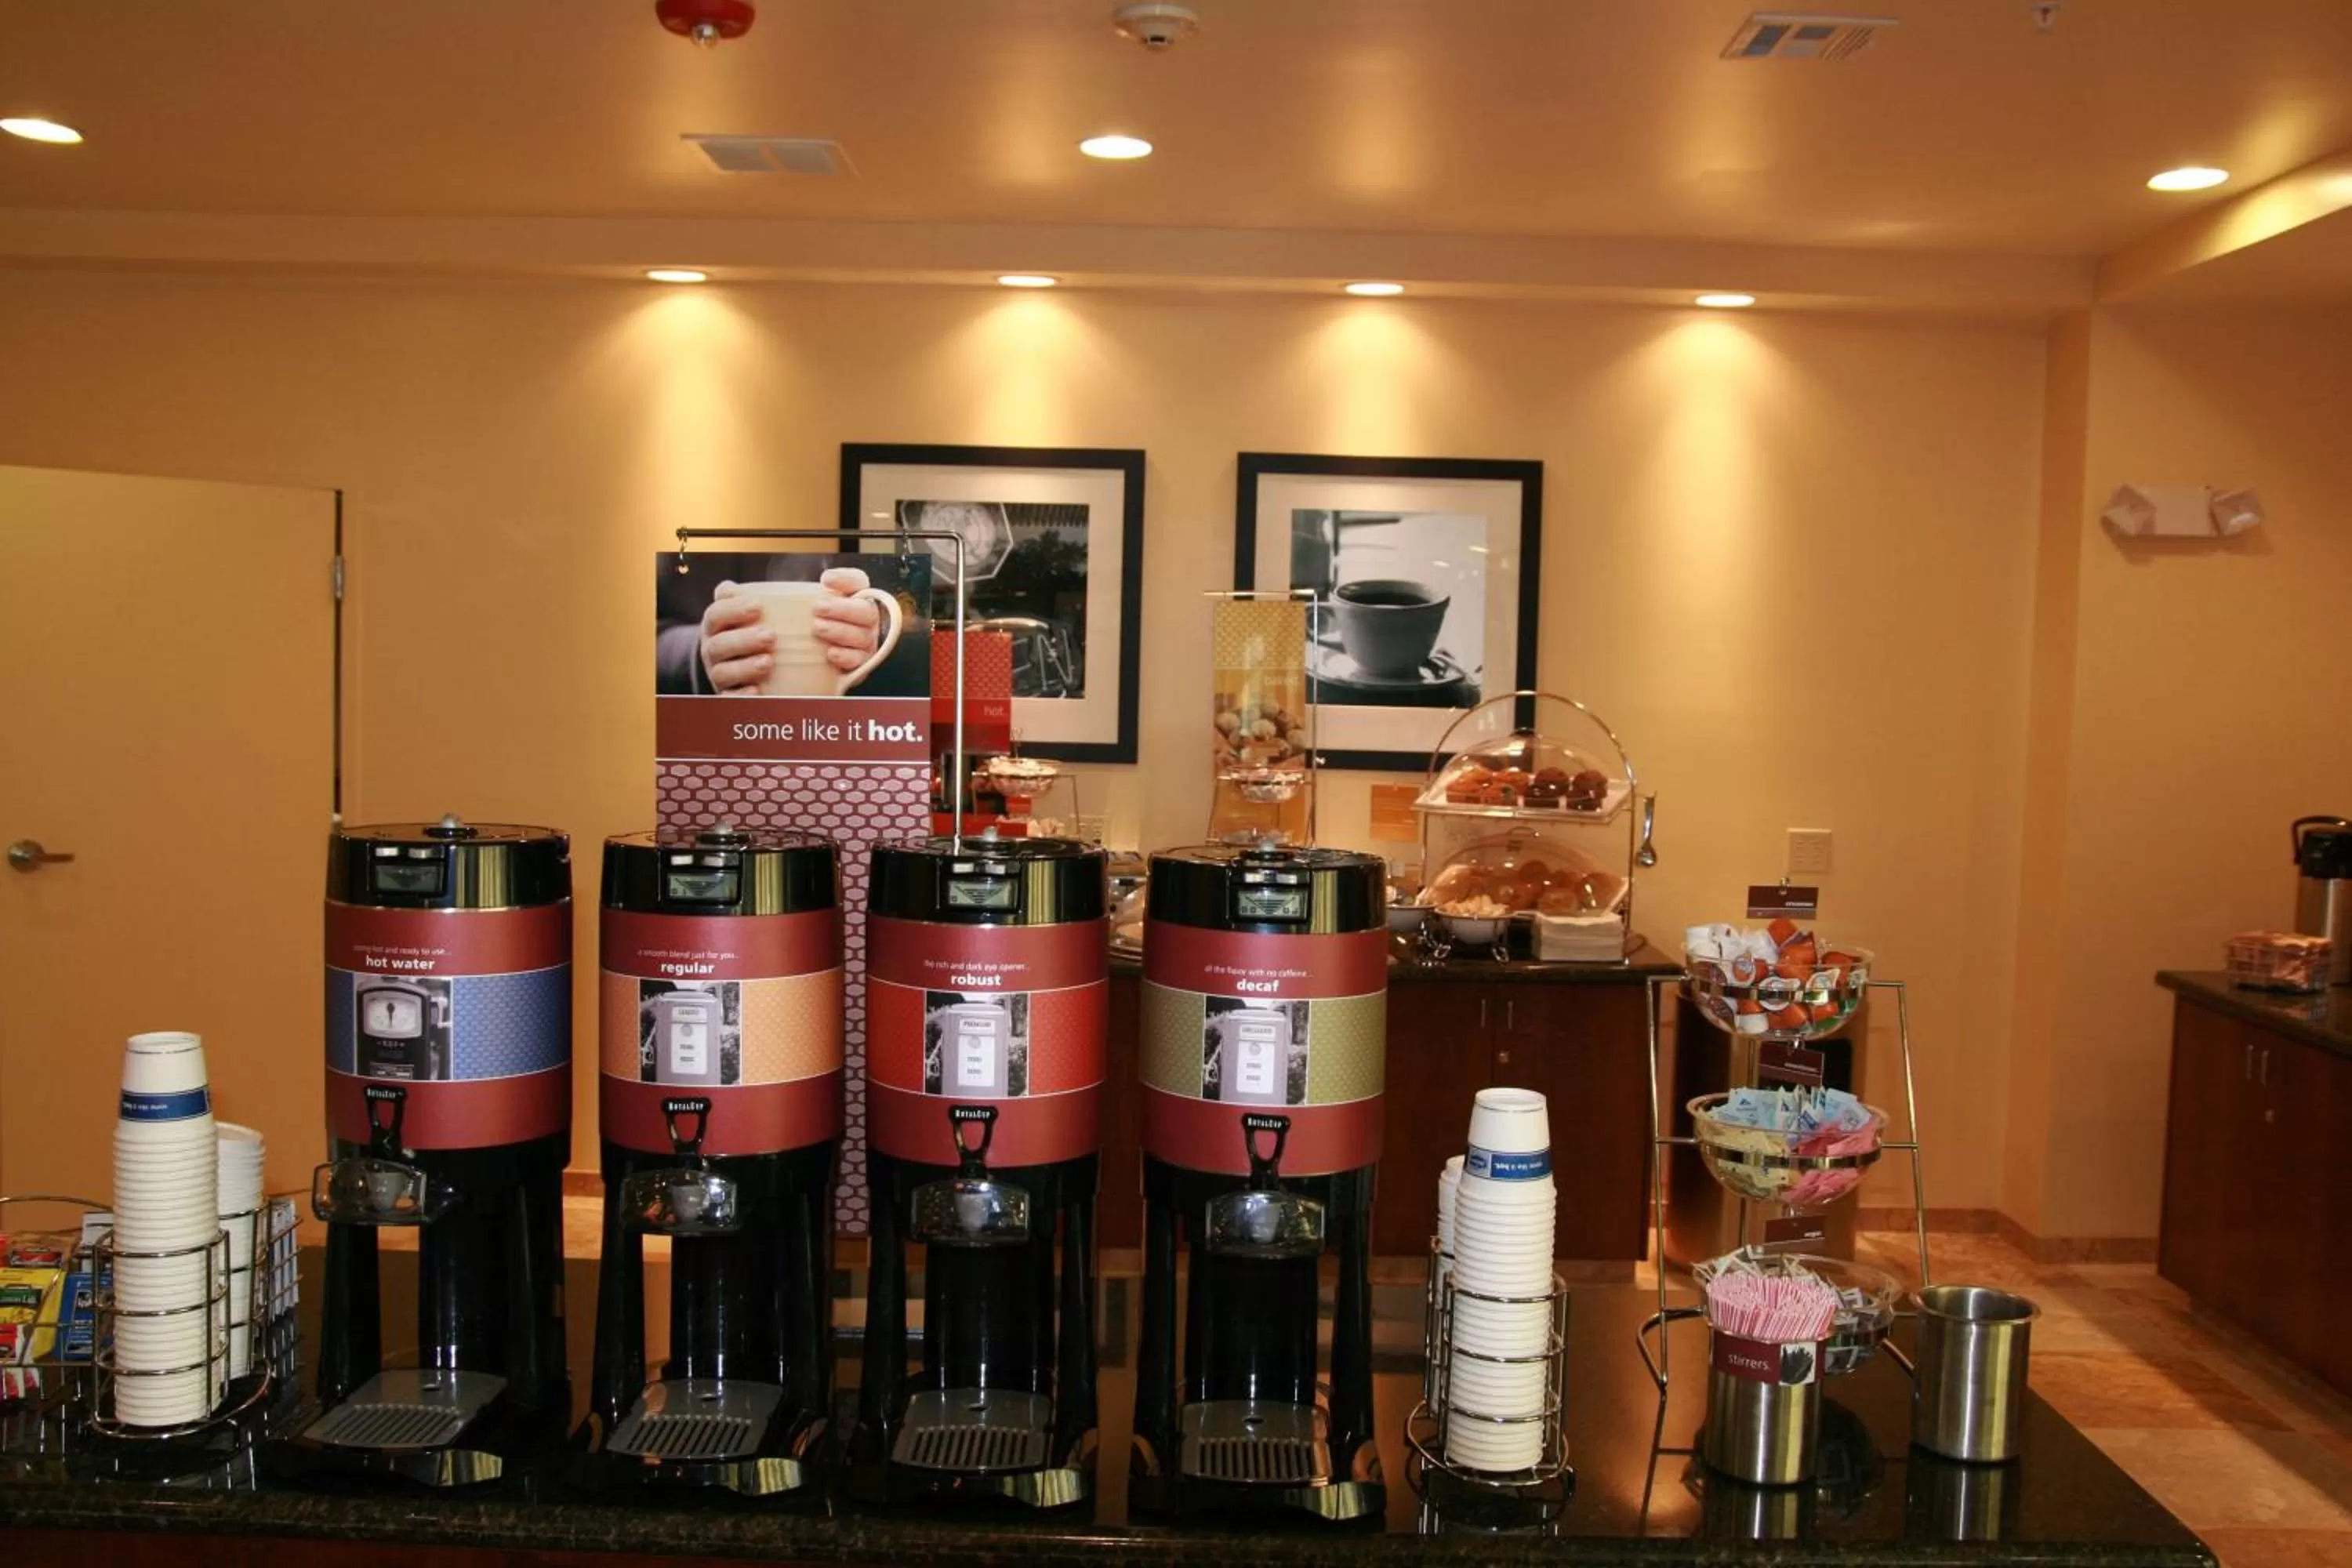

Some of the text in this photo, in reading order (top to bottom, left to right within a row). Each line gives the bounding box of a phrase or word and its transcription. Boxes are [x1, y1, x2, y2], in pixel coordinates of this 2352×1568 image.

[733, 718, 923, 742] some like it hot.
[366, 954, 435, 970] hot water
[661, 962, 715, 975] regular
[951, 973, 1001, 985] robust
[1236, 978, 1279, 992] decaf
